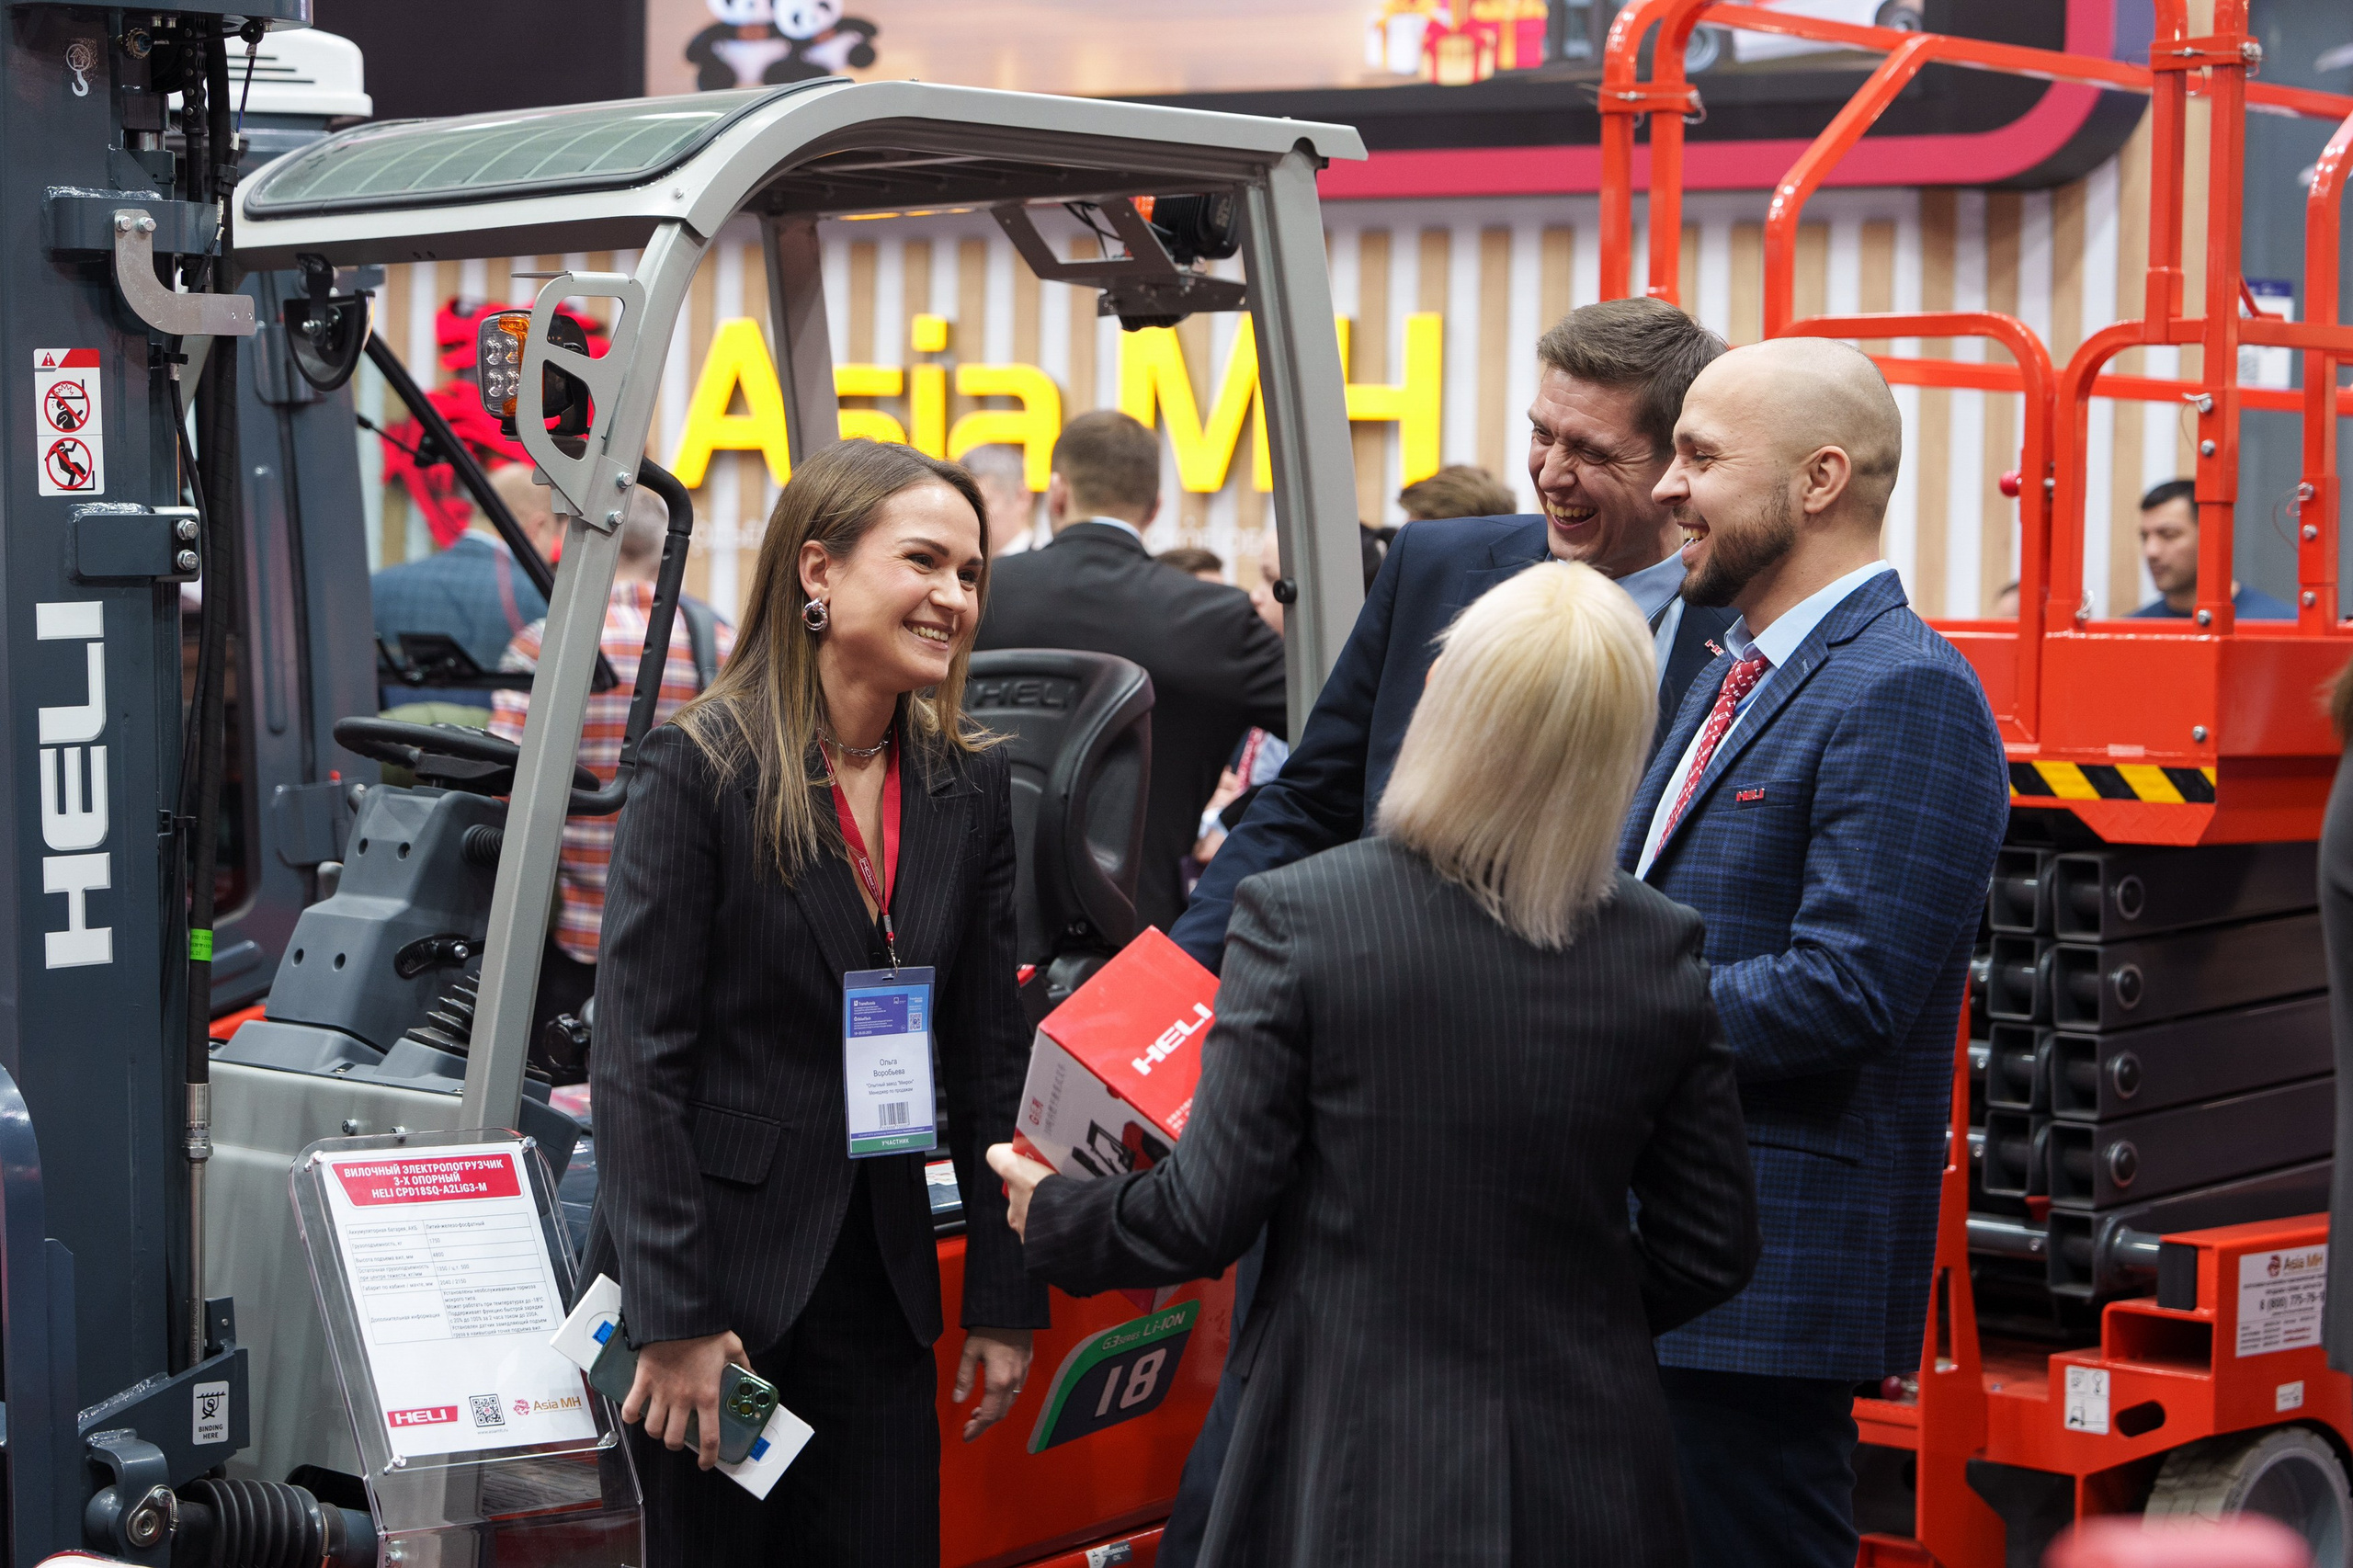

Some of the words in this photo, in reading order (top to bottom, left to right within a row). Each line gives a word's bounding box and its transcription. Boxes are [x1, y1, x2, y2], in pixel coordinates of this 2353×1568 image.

[671, 313, 1062, 493] Asia
[1117, 312, 1442, 494] MH
[36, 600, 113, 969] HELI
[1736, 789, 1765, 801] HELI
[1131, 1002, 1213, 1076] HELI
[873, 1068, 904, 1077] Воробьева
[344, 1164, 401, 1177] ВИЛОЧНЫЙ
[403, 1159, 504, 1175] ЭЛЕКТРОПОГРУЗЧИК
[412, 1172, 460, 1184] ОПОРНЫЙ
[372, 1187, 394, 1198] HELI
[398, 1183, 487, 1197] CPD18SQ-A2LiG3-M
[1142, 1311, 1186, 1336] Li-ION
[1095, 1347, 1167, 1417] 18
[533, 1397, 558, 1411] Asia
[561, 1396, 582, 1408] MH
[394, 1408, 448, 1425] HELI
[199, 1424, 223, 1432] BINDING
